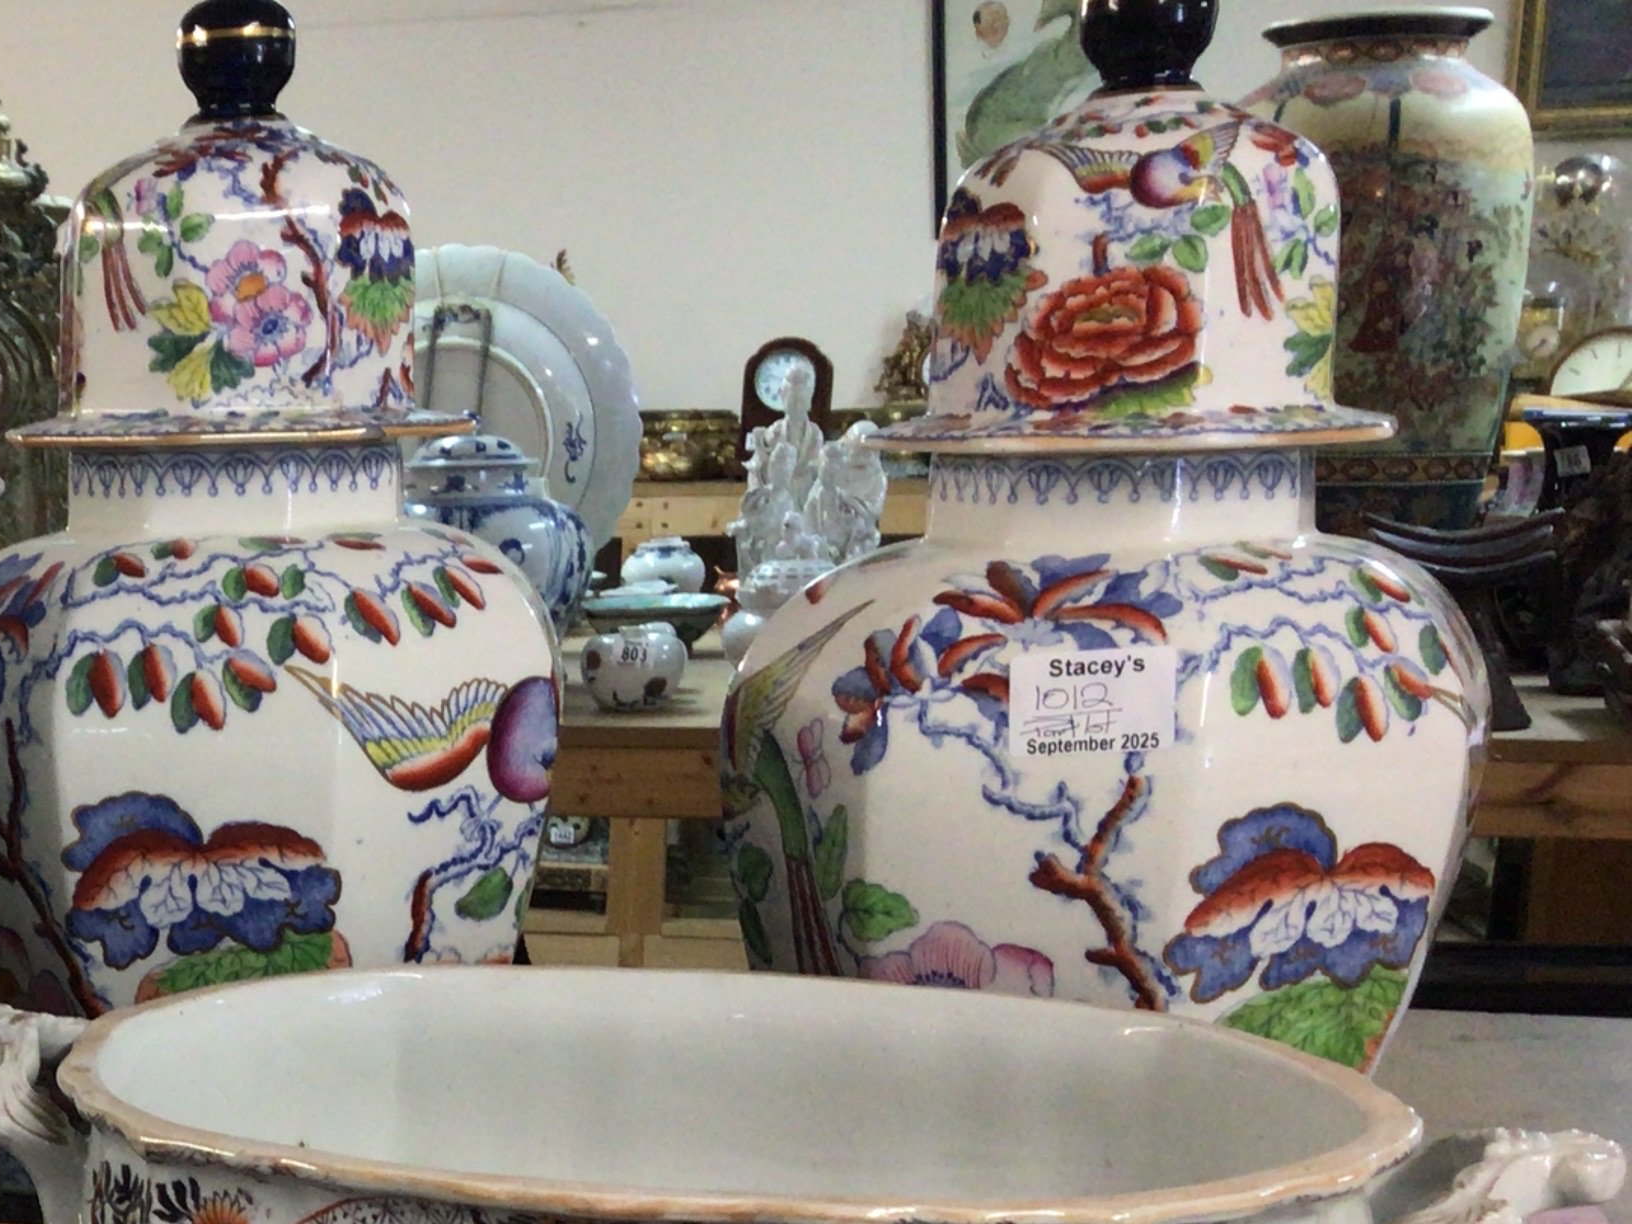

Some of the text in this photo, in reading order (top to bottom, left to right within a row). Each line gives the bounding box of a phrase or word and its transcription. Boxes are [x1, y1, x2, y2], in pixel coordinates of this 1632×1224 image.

[1049, 655, 1146, 678] Stacey's
[1035, 682, 1114, 711] 1012
[1026, 732, 1160, 756] September 2025
